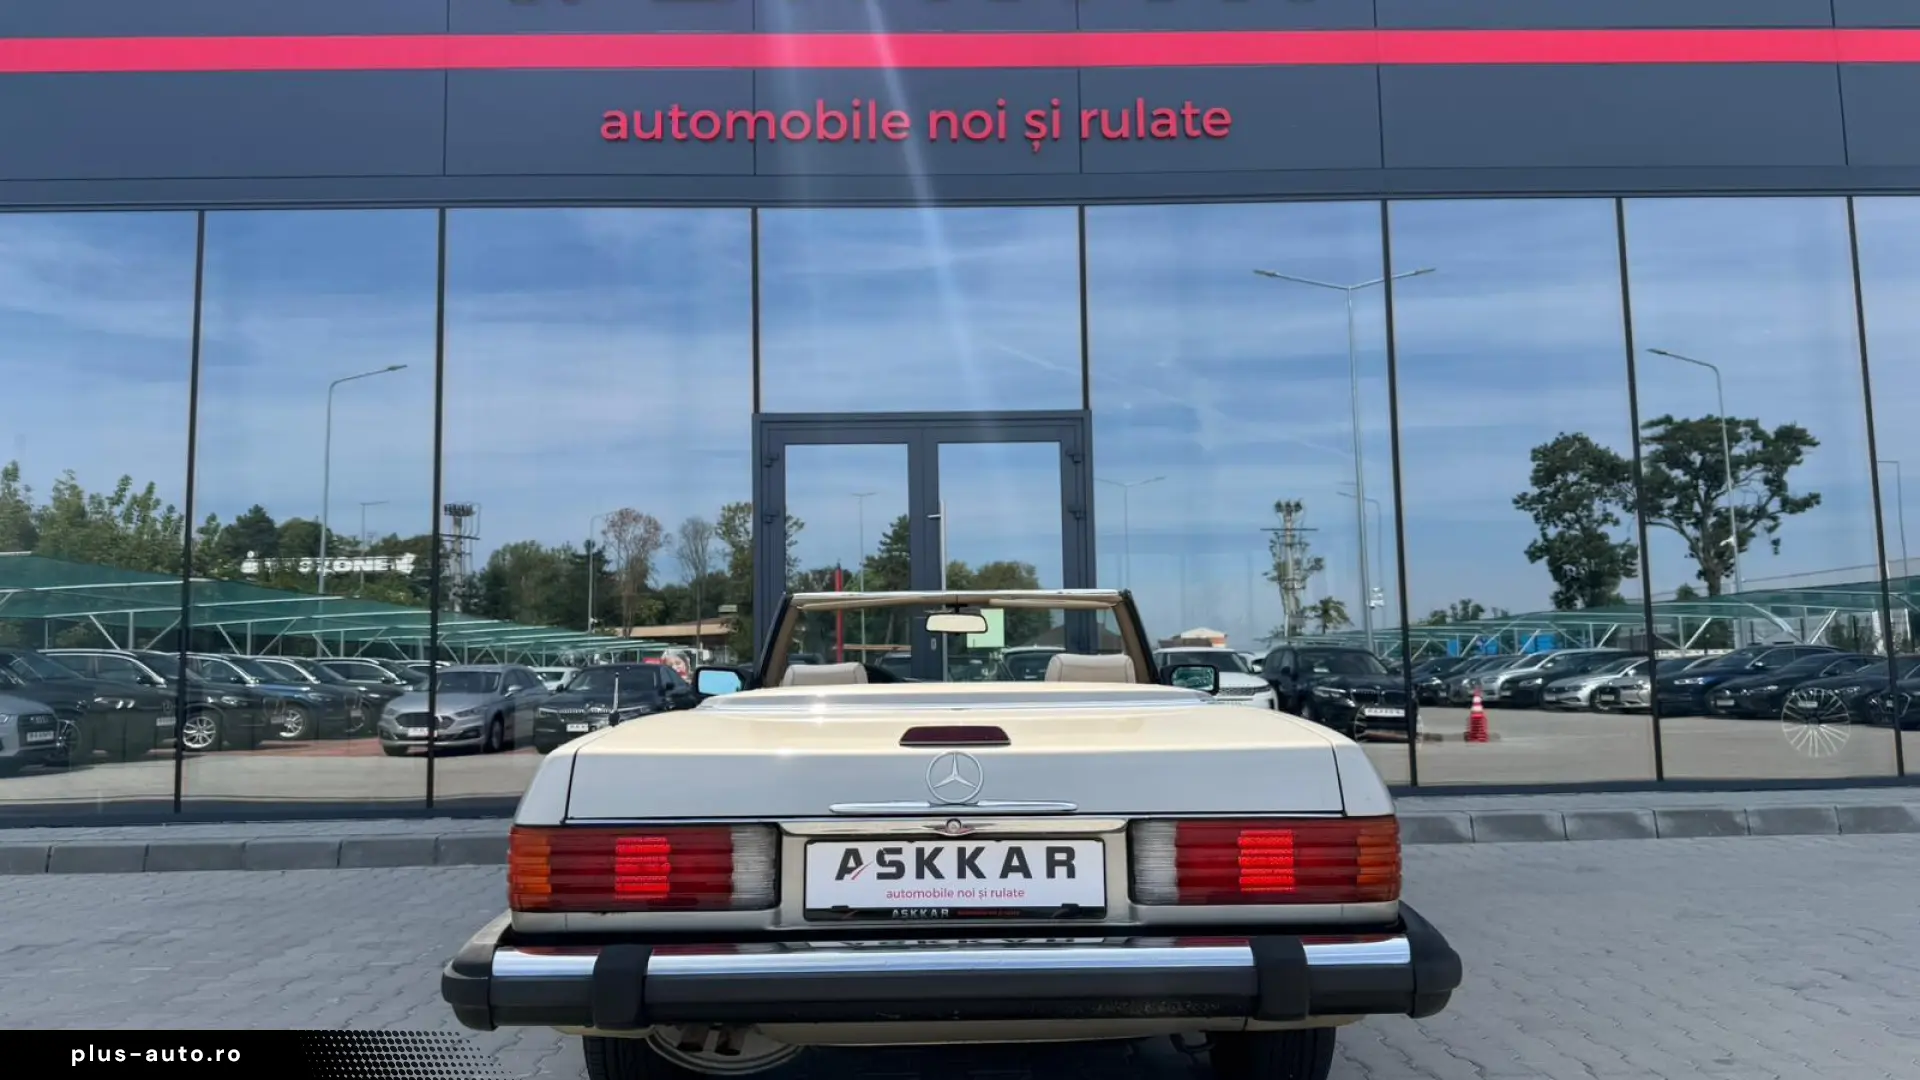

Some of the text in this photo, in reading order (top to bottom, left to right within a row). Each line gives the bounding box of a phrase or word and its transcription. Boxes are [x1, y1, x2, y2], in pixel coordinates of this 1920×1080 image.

[599, 98, 1232, 154] automobile noi și rulate
[834, 846, 1077, 881] ASKKAR
[886, 887, 954, 899] automobile
[957, 887, 975, 898] noi
[990, 887, 1025, 898] rulate
[891, 908, 949, 918] ASKKAR
